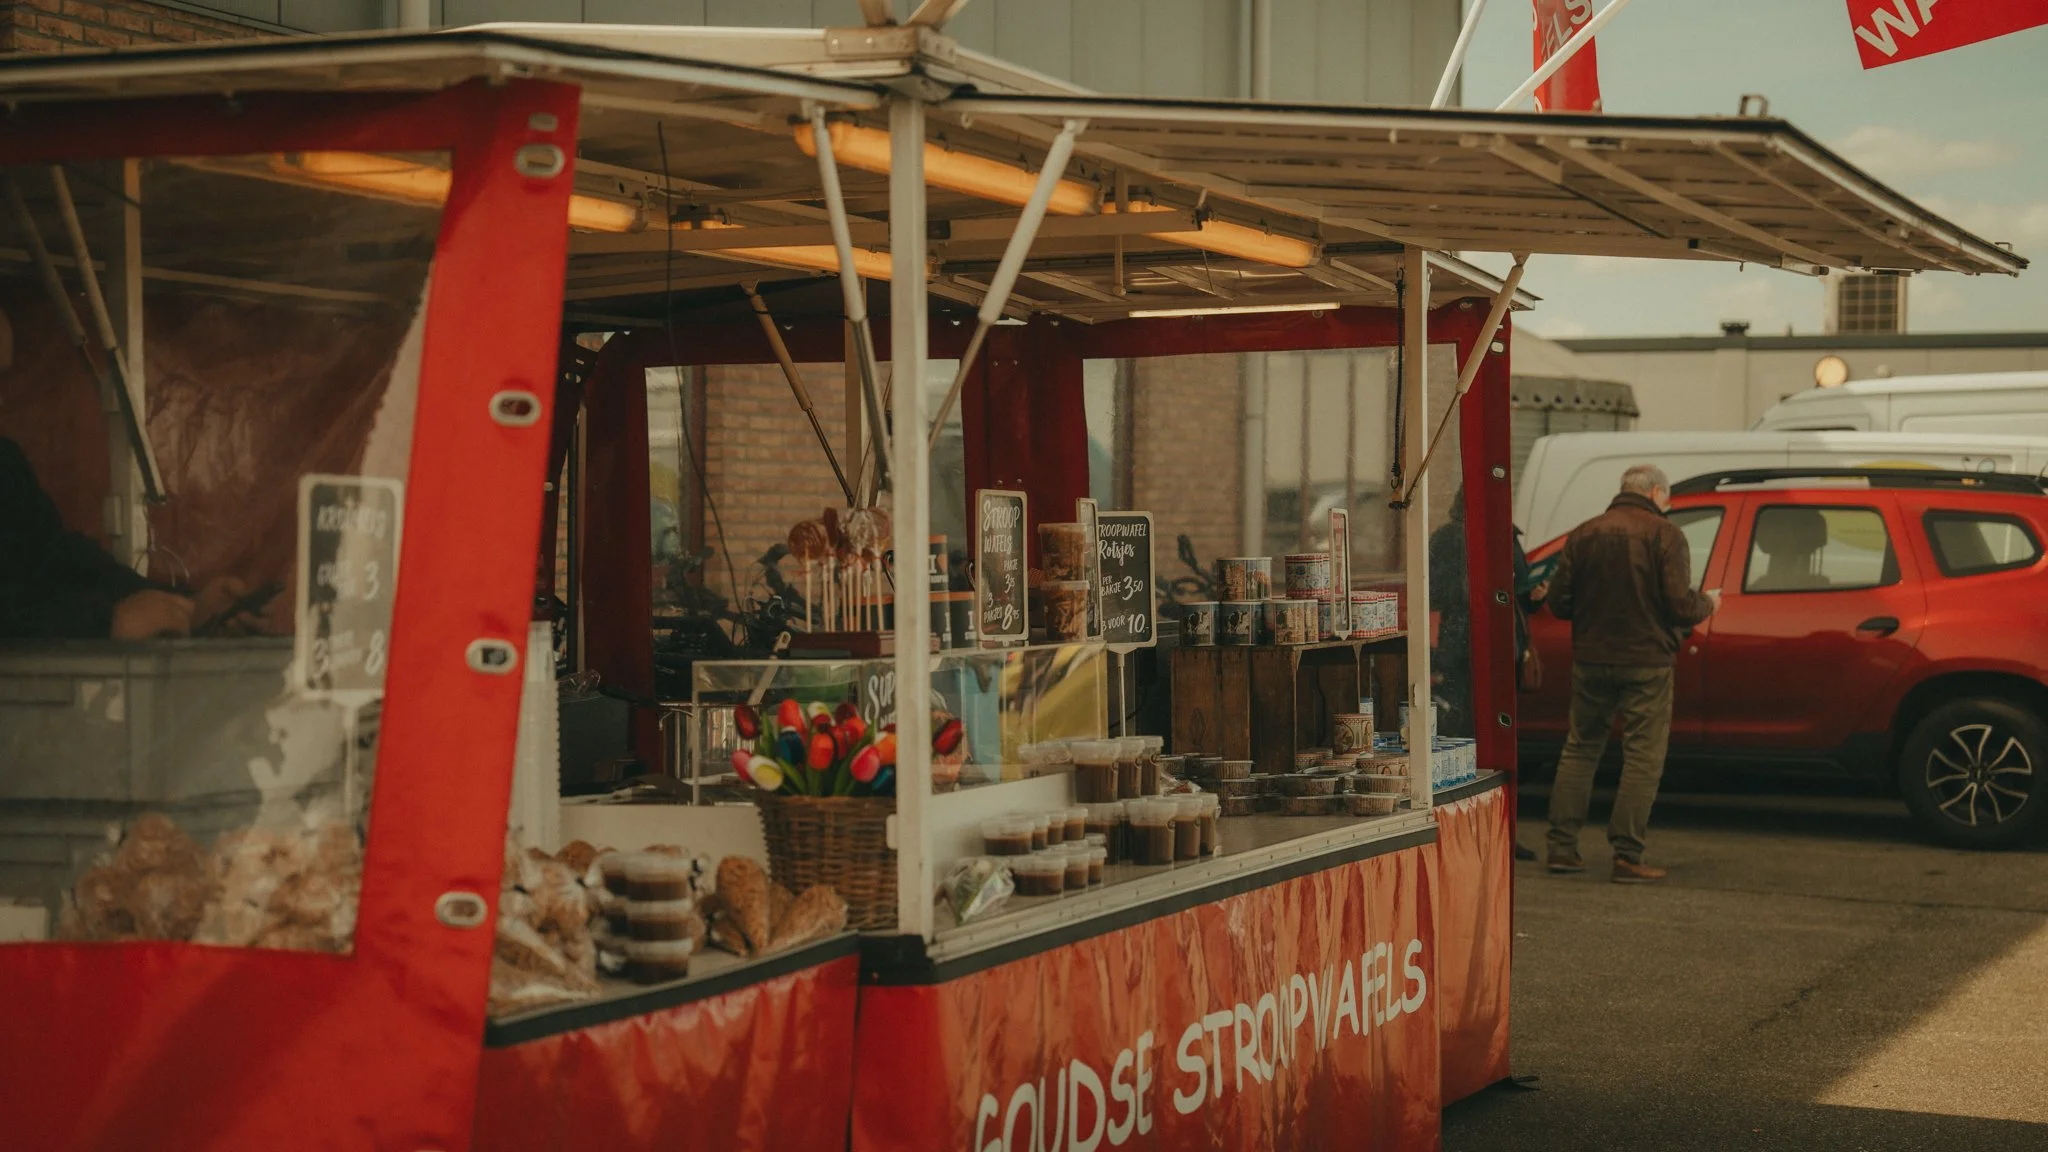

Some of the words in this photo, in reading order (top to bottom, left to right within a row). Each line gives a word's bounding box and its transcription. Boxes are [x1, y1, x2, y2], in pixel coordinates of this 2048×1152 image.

[983, 500, 1020, 531] STROOP
[984, 535, 1012, 555] WAFELS
[1103, 575, 1112, 585] PER
[1101, 582, 1121, 597] BAKJE
[1108, 615, 1125, 629] VOOR
[975, 1031, 1154, 1152] GOUDSE
[1173, 938, 1427, 1115] STROOPWAFELS
